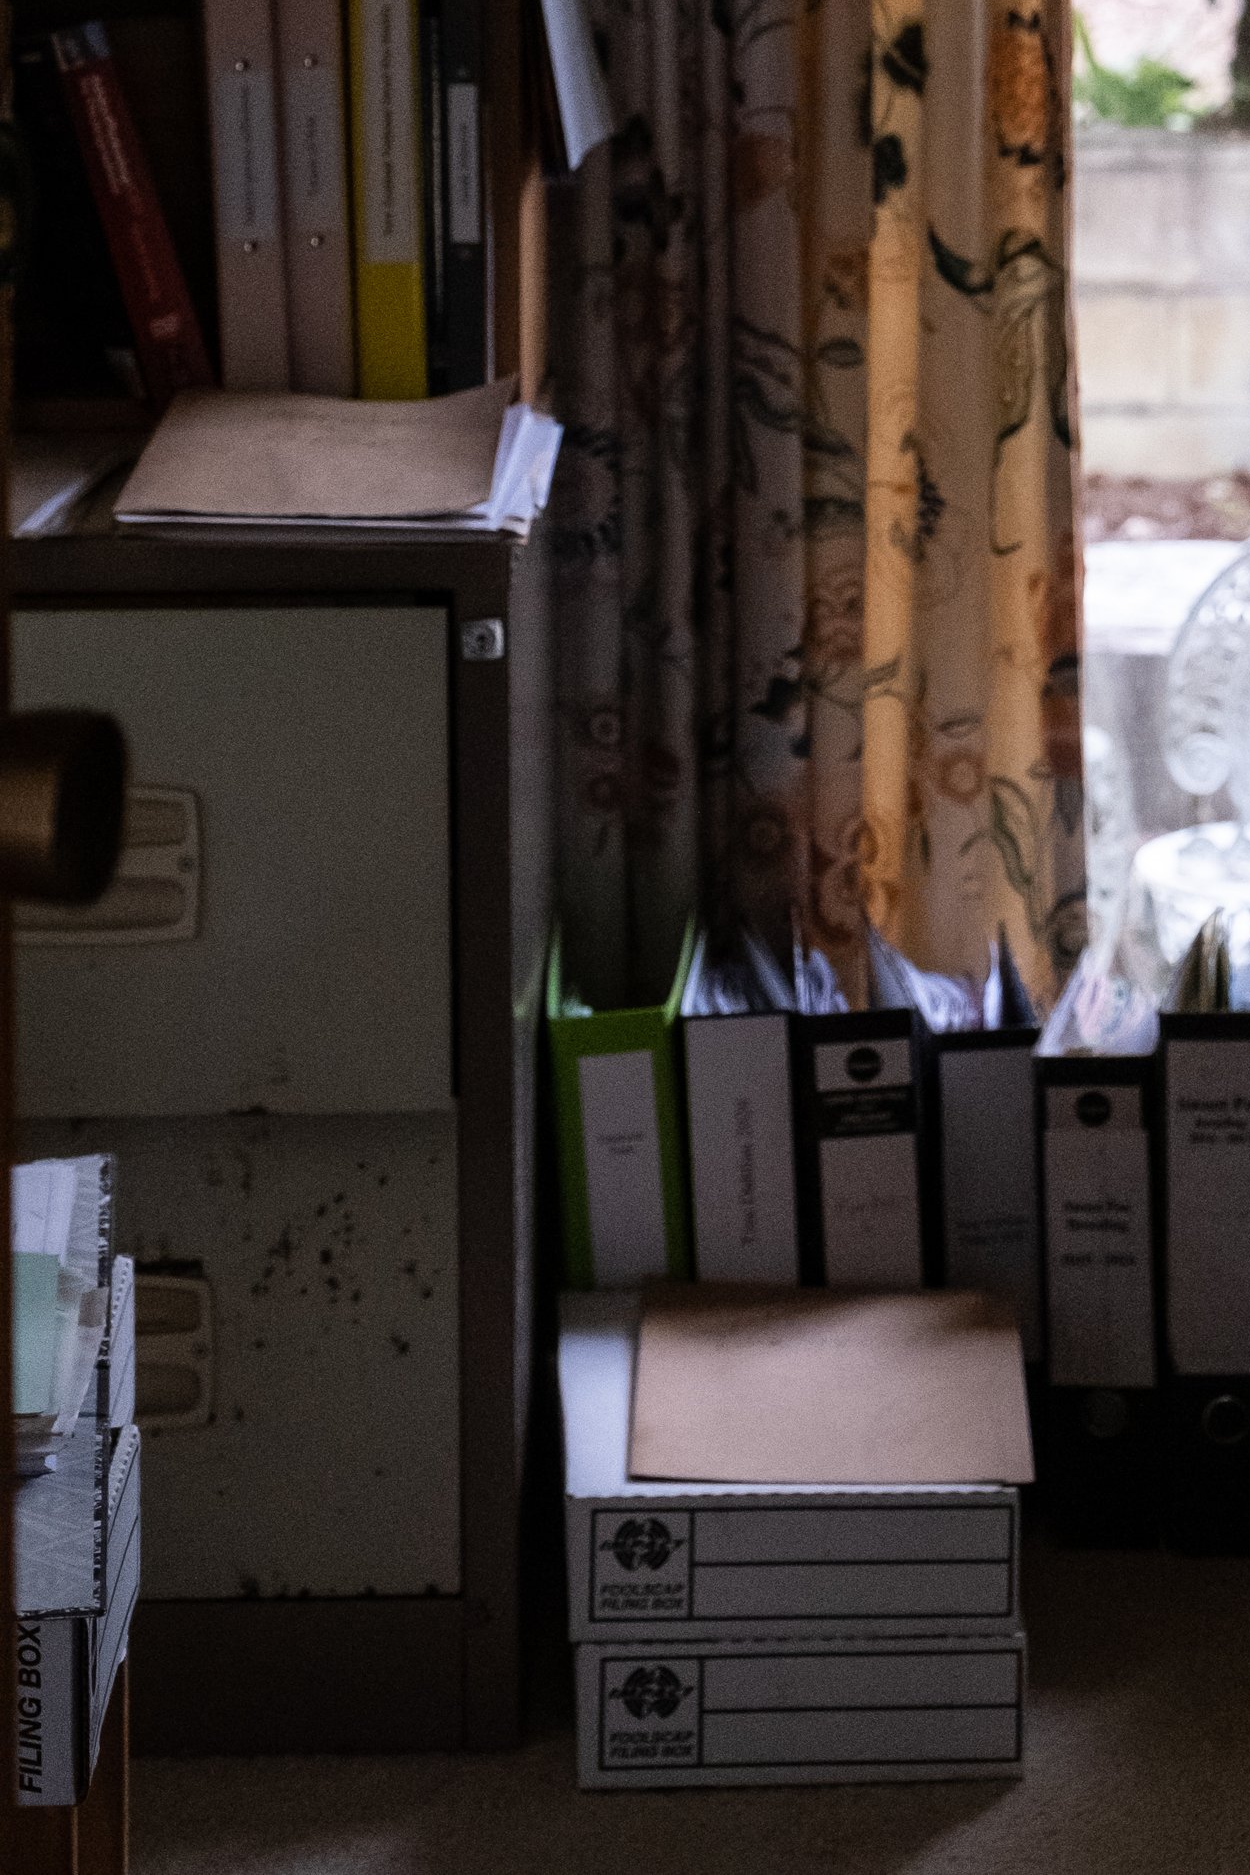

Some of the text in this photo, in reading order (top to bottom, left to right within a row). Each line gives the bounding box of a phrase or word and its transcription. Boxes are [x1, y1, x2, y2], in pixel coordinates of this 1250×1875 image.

[600, 1583, 685, 1597] FOOLSCAP
[599, 1597, 684, 1611] FILING BOX
[18, 1623, 43, 1794] FILING BOX
[609, 1731, 695, 1744] FOOLSCAP
[609, 1745, 693, 1759] FILING BOX
